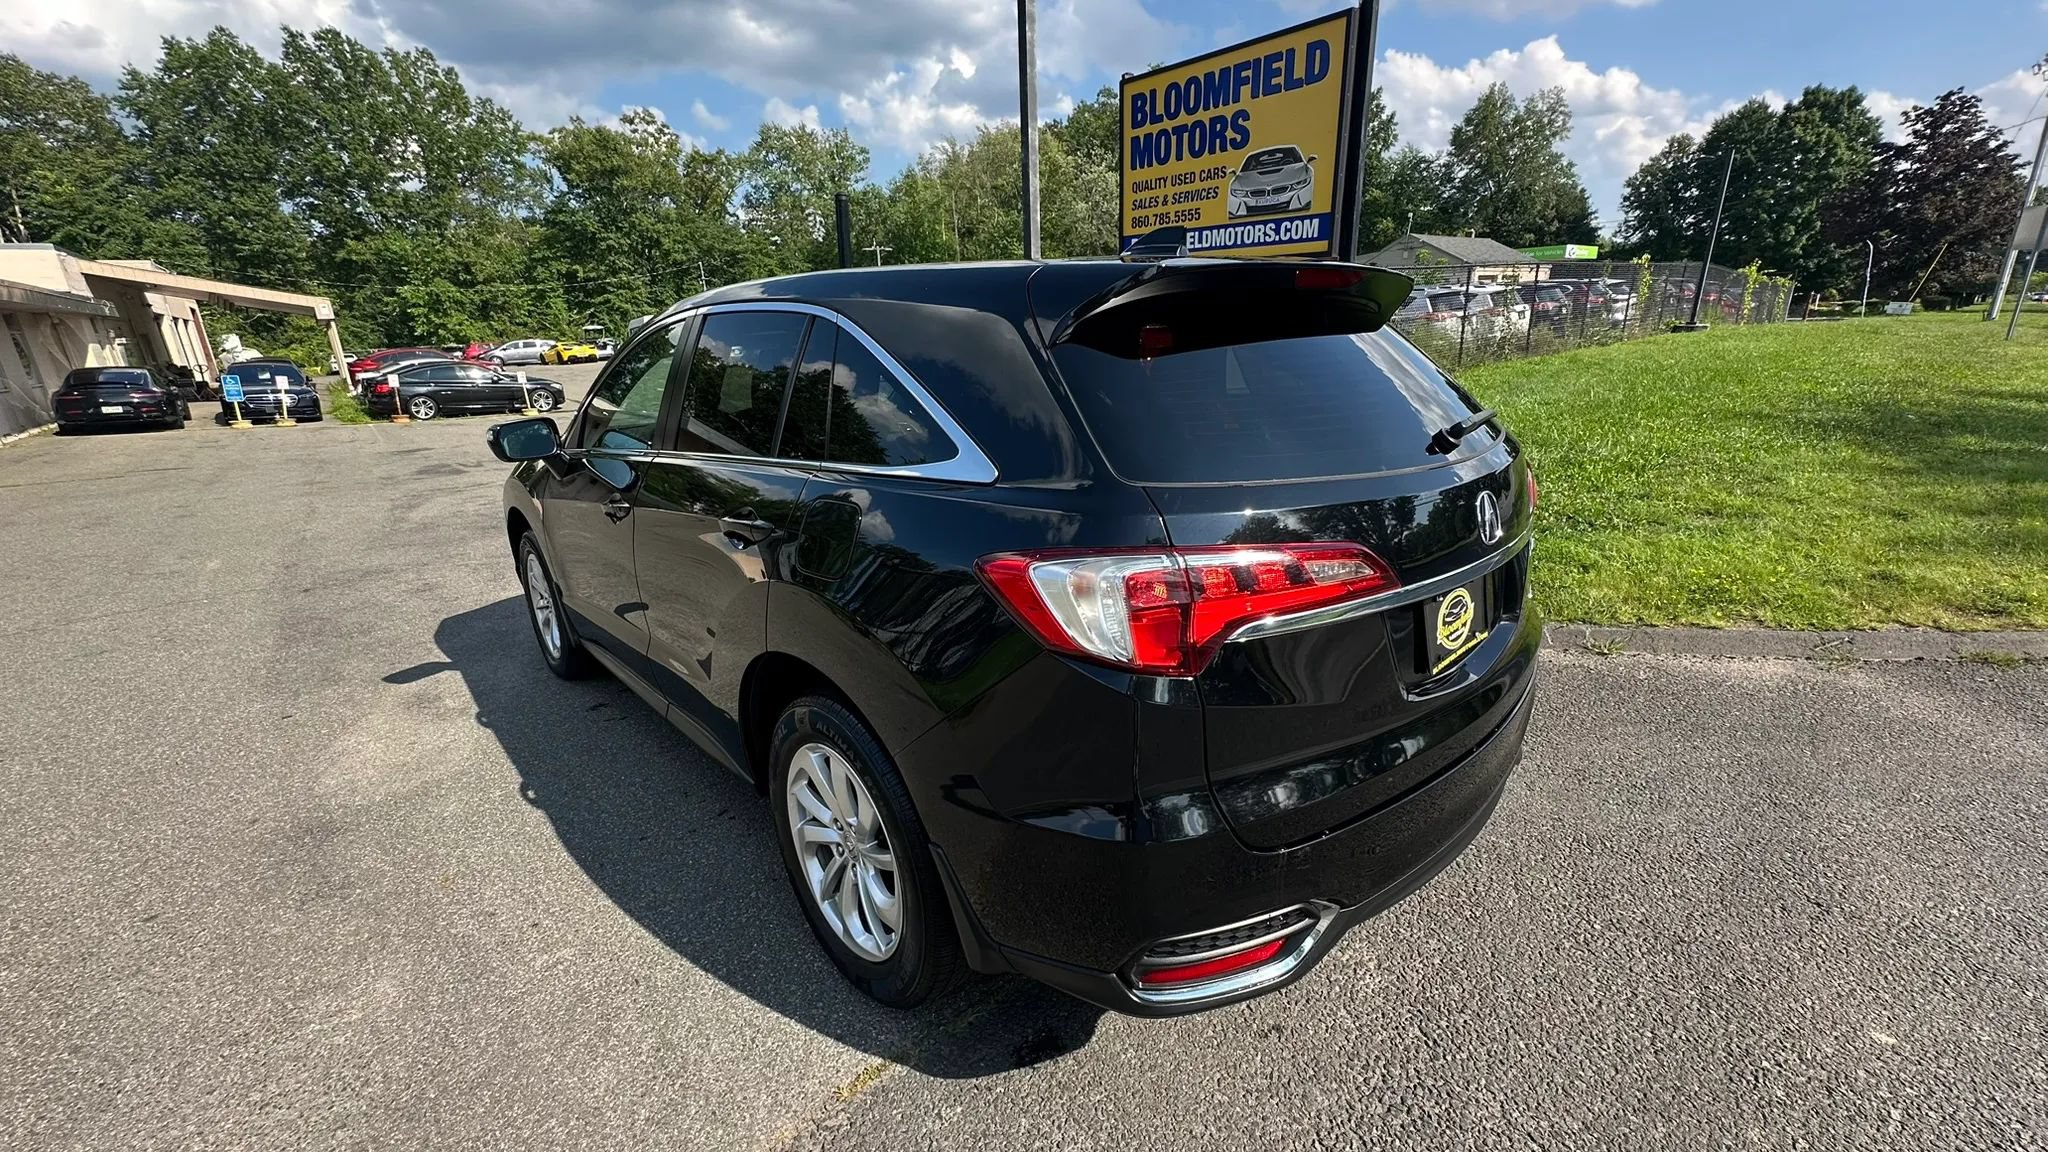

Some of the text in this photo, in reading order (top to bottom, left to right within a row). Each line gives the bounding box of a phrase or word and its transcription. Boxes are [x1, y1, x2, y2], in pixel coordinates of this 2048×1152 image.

[1131, 39, 1331, 130] BLOOMFIELD
[1130, 109, 1250, 171] MOTORS
[1132, 165, 1227, 194] QUALITY USED CARS
[1131, 186, 1219, 211] SALES & SERVICES
[1131, 208, 1201, 229] 860.785.5555
[1131, 218, 1319, 249] ELDMOTORS.COM
